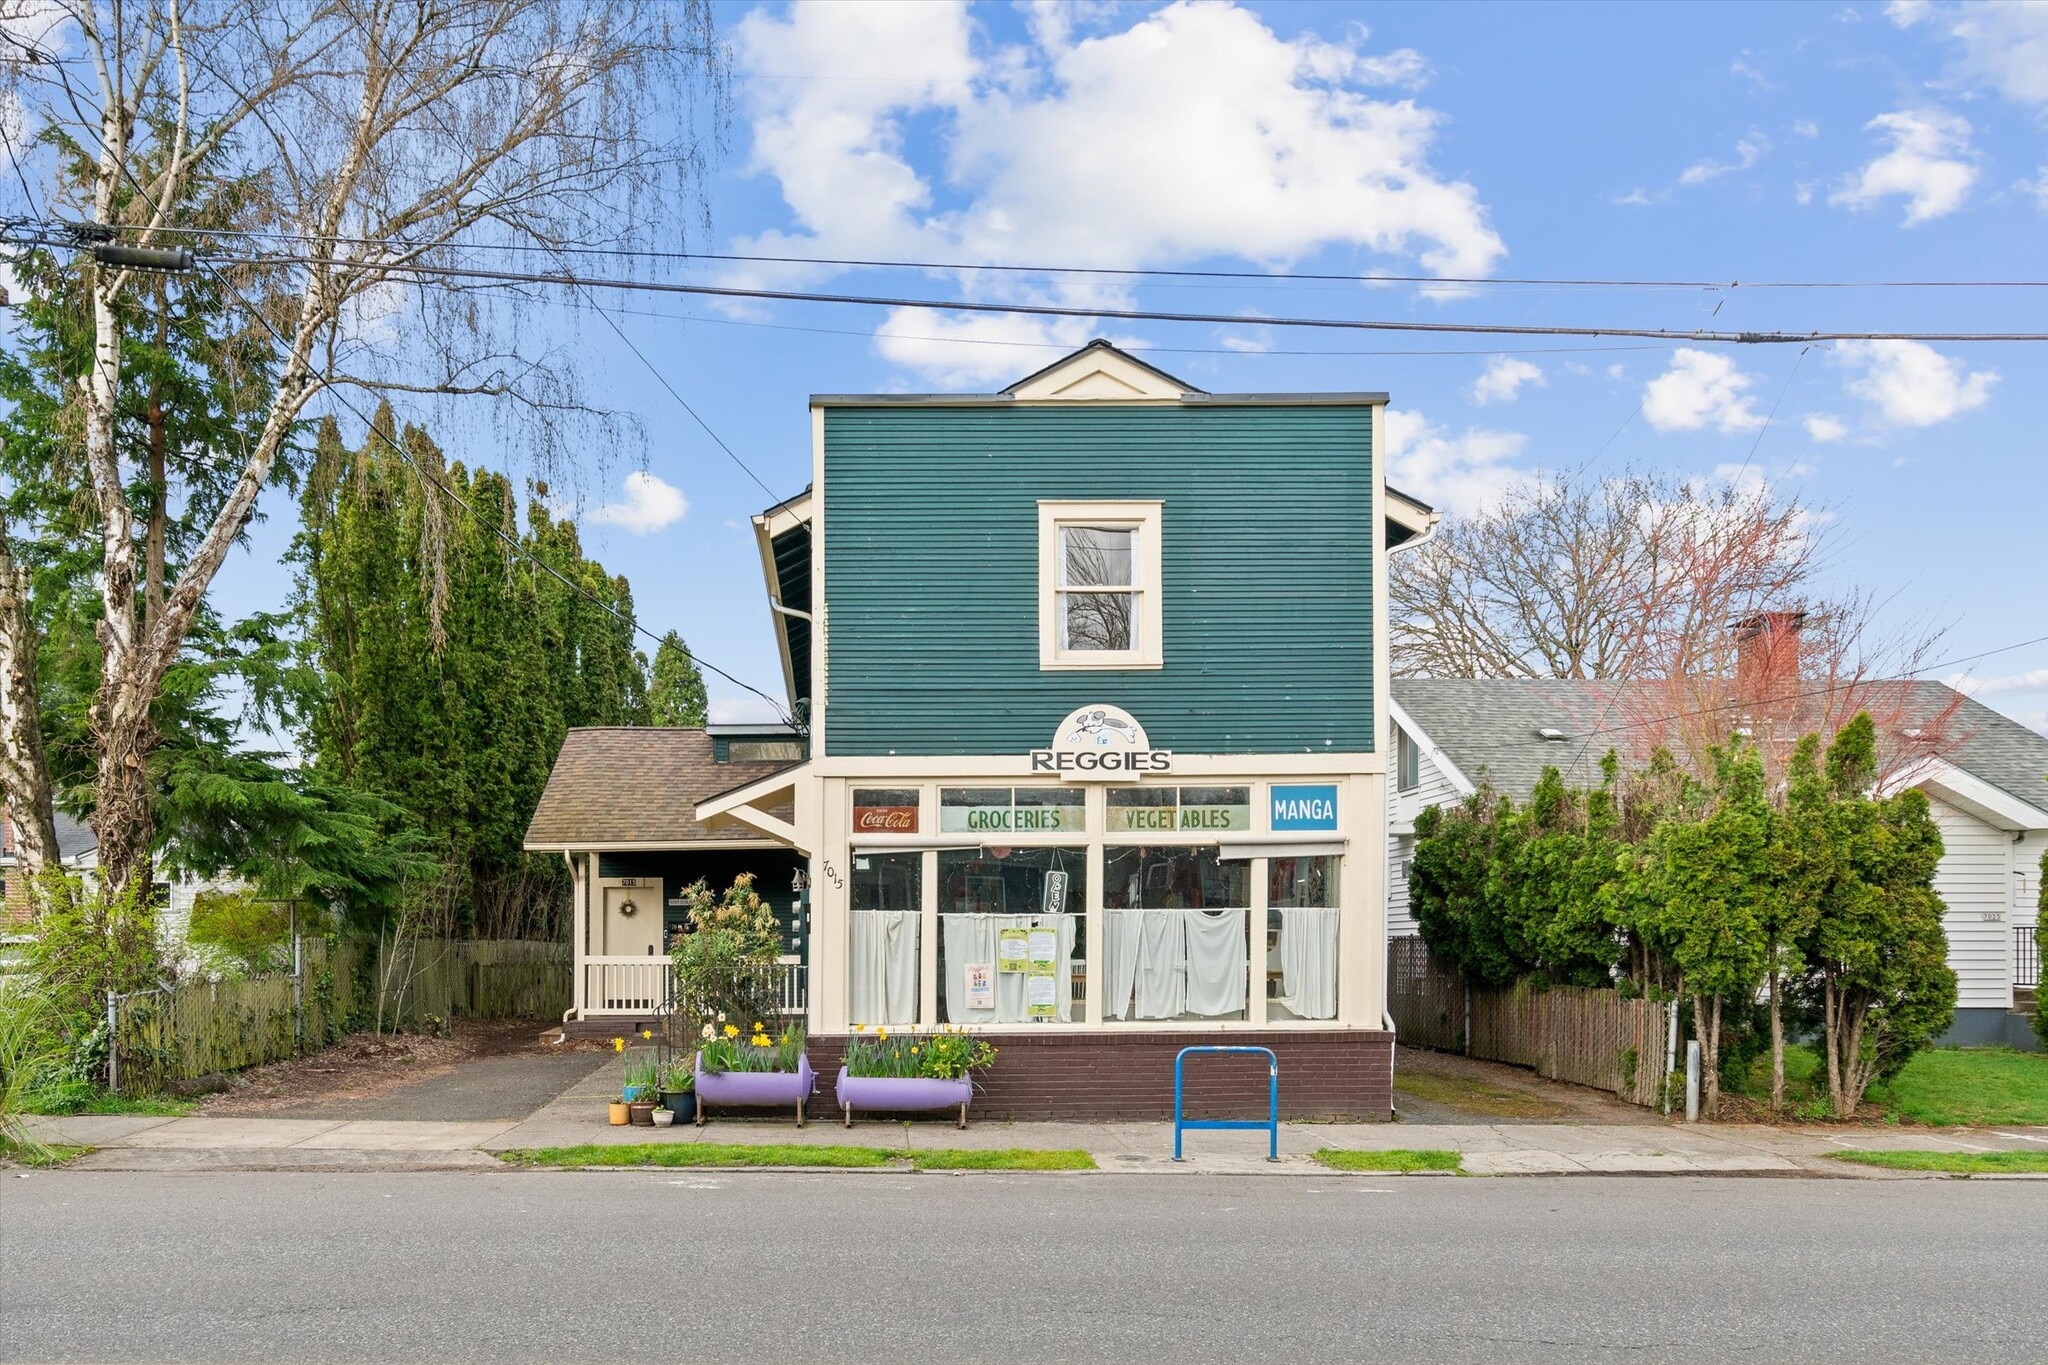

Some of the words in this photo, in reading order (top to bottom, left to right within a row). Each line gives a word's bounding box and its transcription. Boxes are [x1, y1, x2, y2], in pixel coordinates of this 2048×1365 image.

[1031, 751, 1171, 771] REGGIES
[860, 811, 912, 828] Coca-Cola
[967, 810, 1060, 829] GROCERIES
[1274, 799, 1334, 820] MANGA
[823, 860, 844, 890] 7015
[1050, 873, 1062, 912] OPEN
